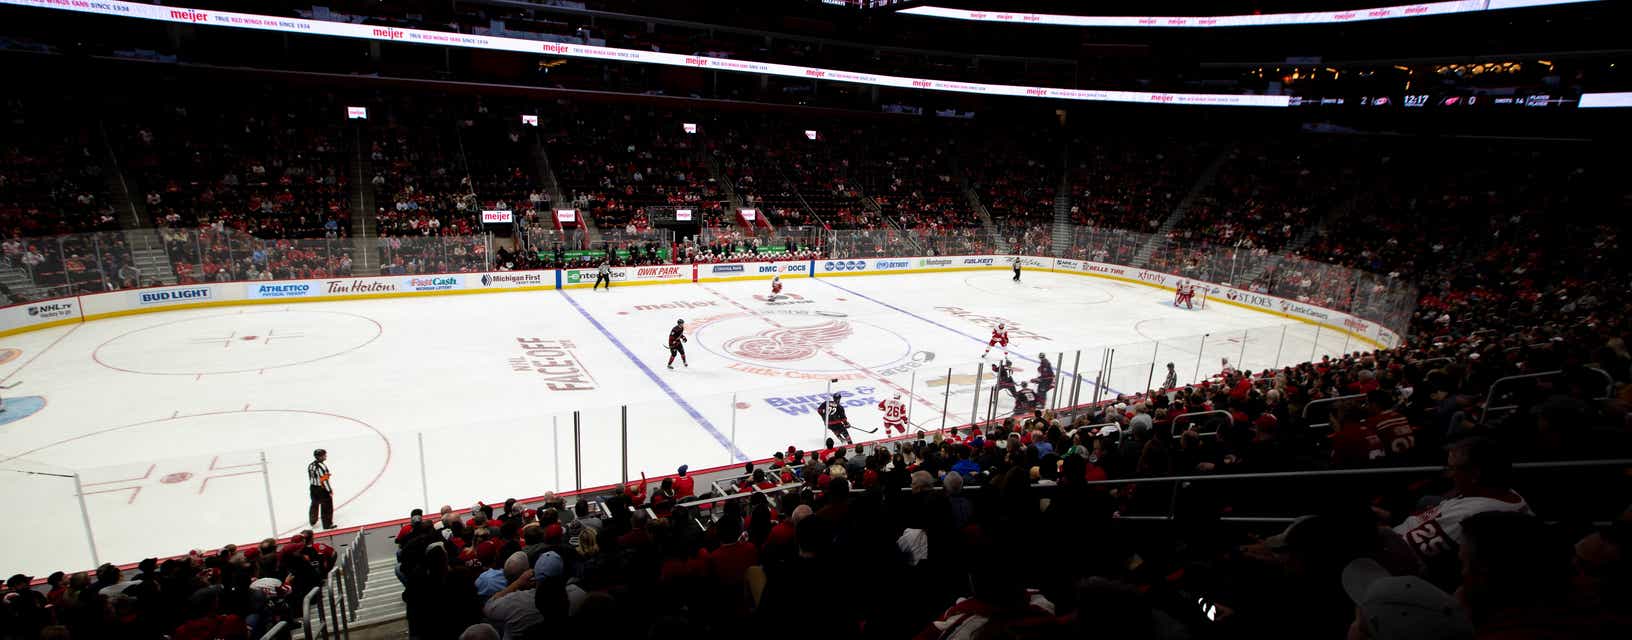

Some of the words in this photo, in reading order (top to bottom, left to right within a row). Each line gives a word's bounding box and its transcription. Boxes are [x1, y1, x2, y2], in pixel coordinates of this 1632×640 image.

[170, 9, 208, 22] meijer
[373, 27, 404, 39] meijer
[543, 43, 568, 54] meijer
[685, 56, 707, 67] meijer
[806, 69, 824, 78] meijer
[912, 79, 932, 88] meijer
[1361, 96, 1367, 105] 2
[1404, 95, 1429, 106] 12:17
[484, 211, 509, 222] meijer
[658, 267, 680, 275] PARK
[492, 275, 524, 283] Michigan
[525, 273, 541, 281] First
[1138, 271, 1166, 284] xfinity
[259, 284, 309, 293] ATHLETICO
[327, 280, 348, 293] Tim
[350, 280, 395, 293] Hortons
[142, 292, 169, 301] BUD
[171, 289, 208, 299] LIGHT
[887, 405, 899, 418] 26
